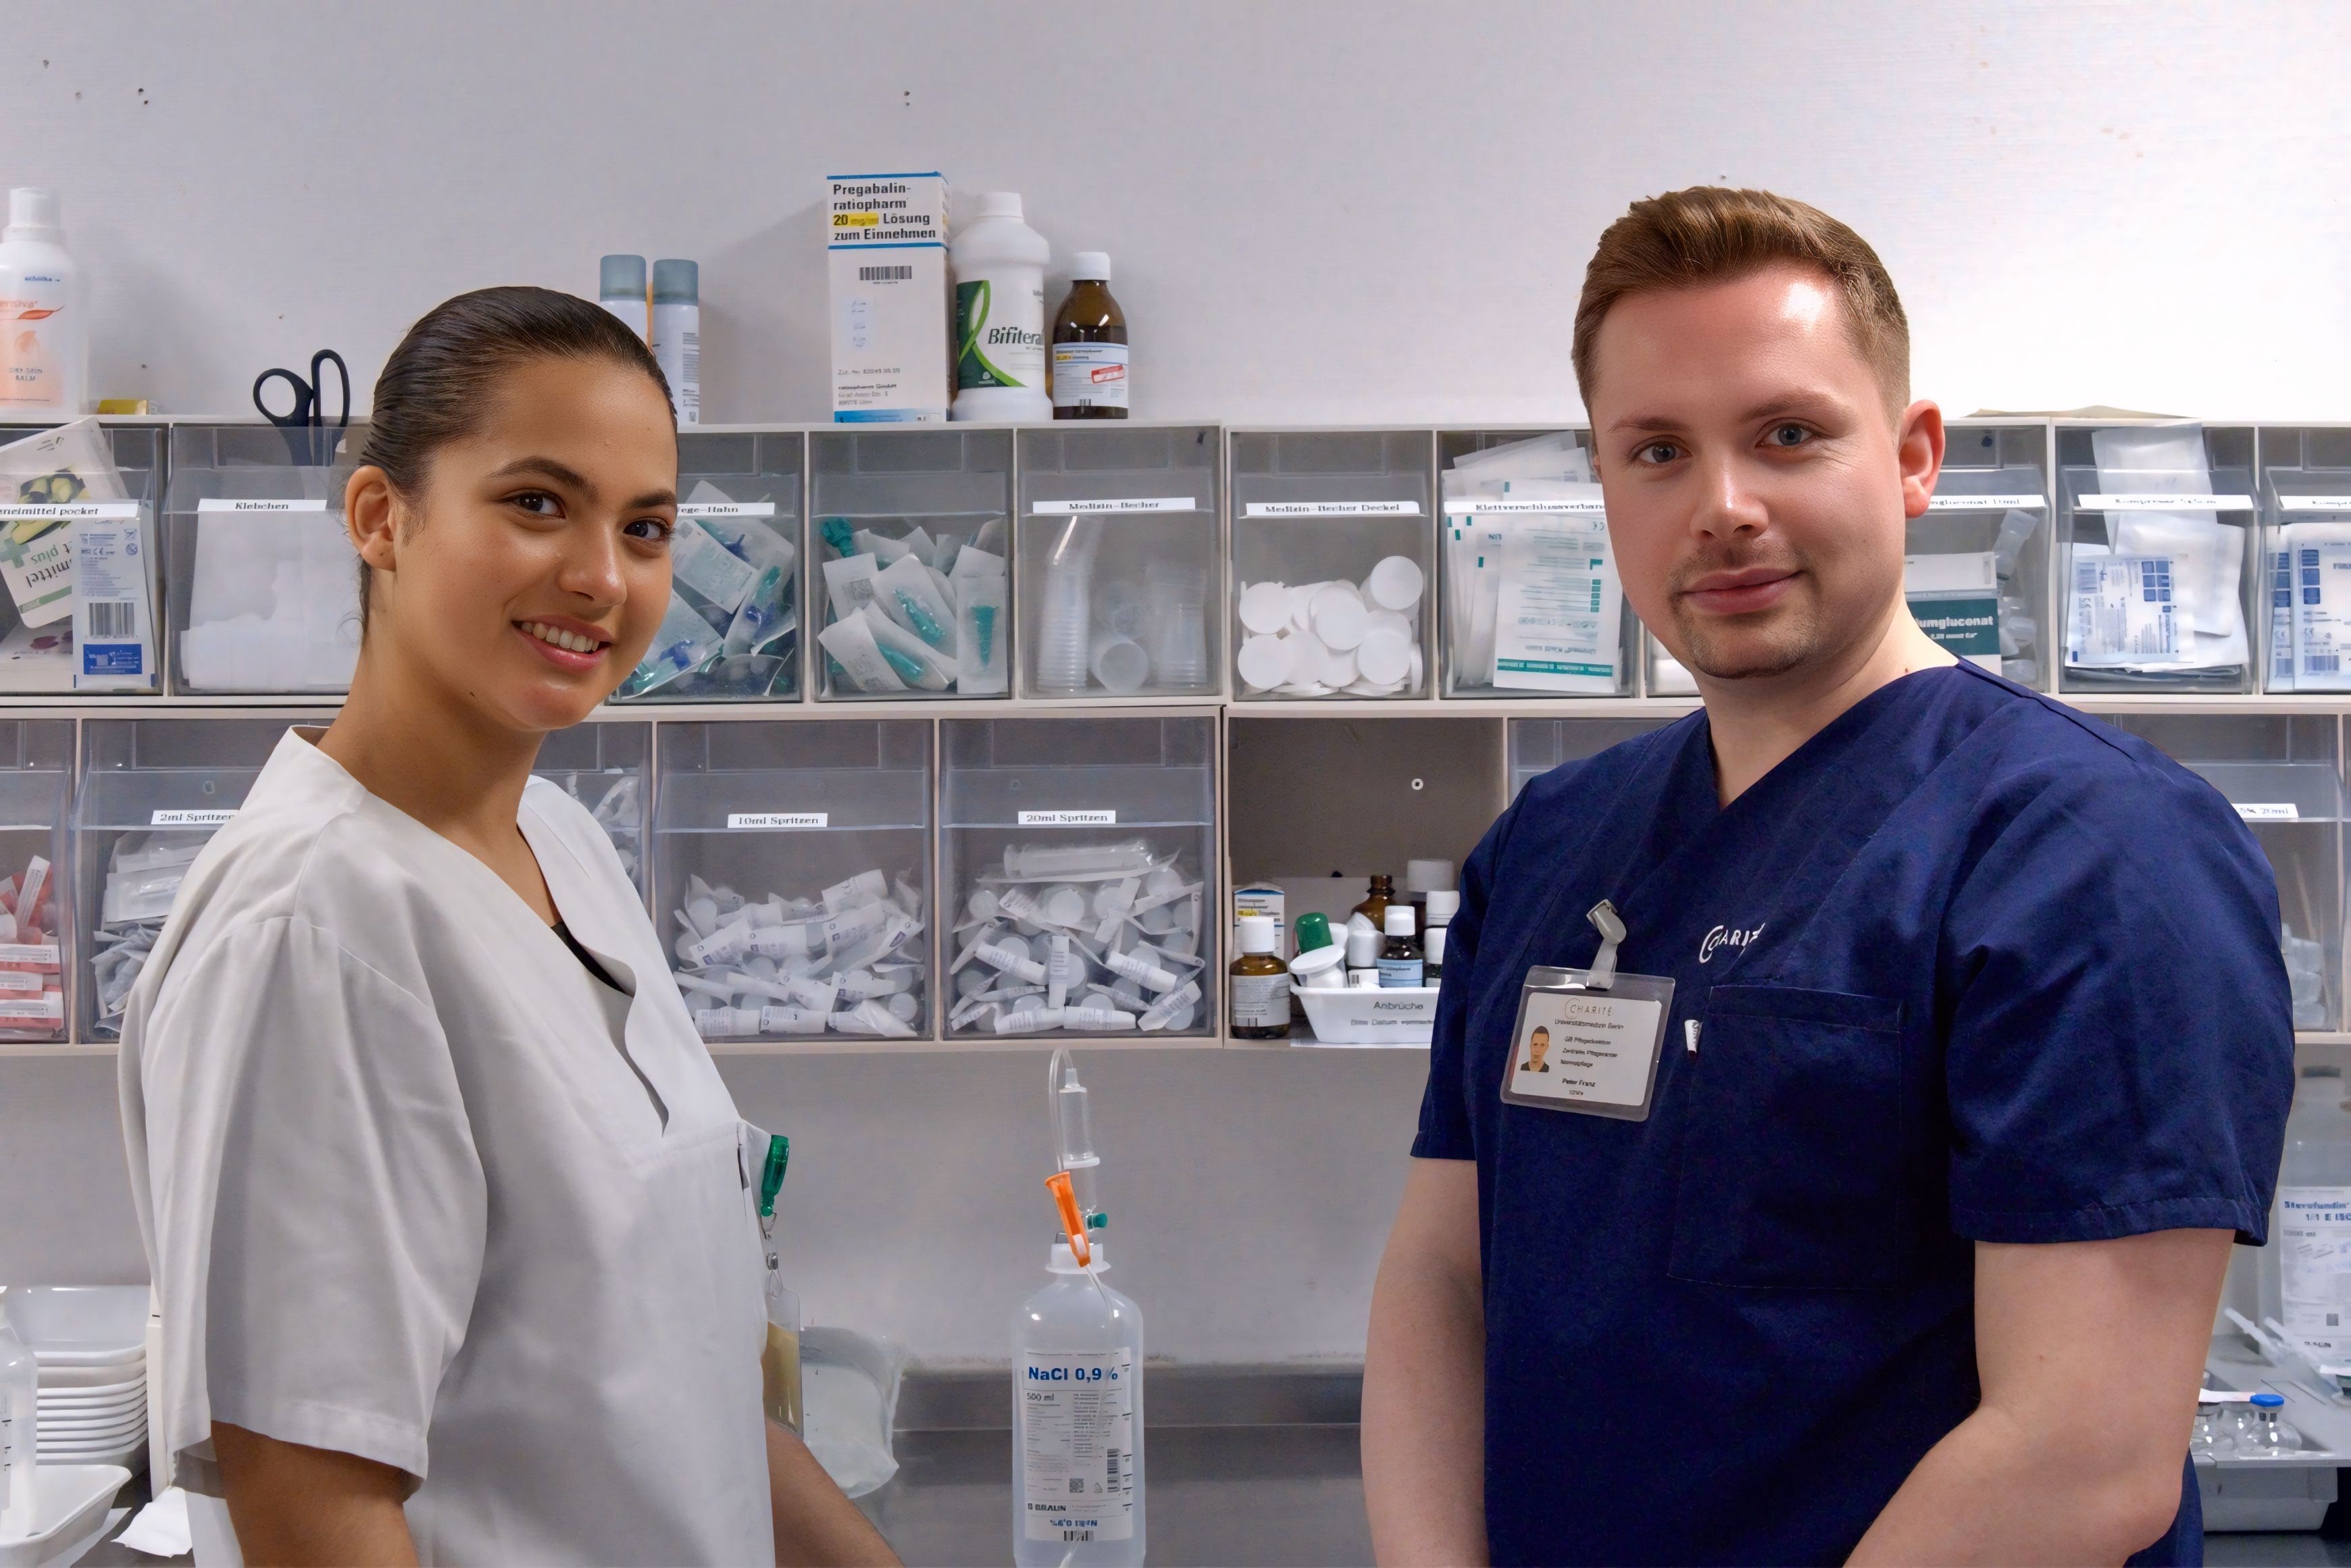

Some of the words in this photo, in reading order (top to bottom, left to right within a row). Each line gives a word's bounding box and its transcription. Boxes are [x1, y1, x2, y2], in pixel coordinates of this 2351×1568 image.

[833, 182, 911, 197] Pregabalin-
[833, 214, 849, 226] 20
[883, 213, 930, 226] Lösung
[834, 232, 860, 241] zum
[864, 228, 936, 240] Einnehmen
[677, 506, 738, 514] ege-Hahn
[159, 813, 182, 821] 2ml
[738, 817, 766, 825] 10ml
[770, 816, 819, 826] Spritzen
[1026, 814, 1056, 822] 20ml
[1059, 813, 1108, 823] Spritzen
[1028, 1367, 1068, 1380] NaCl
